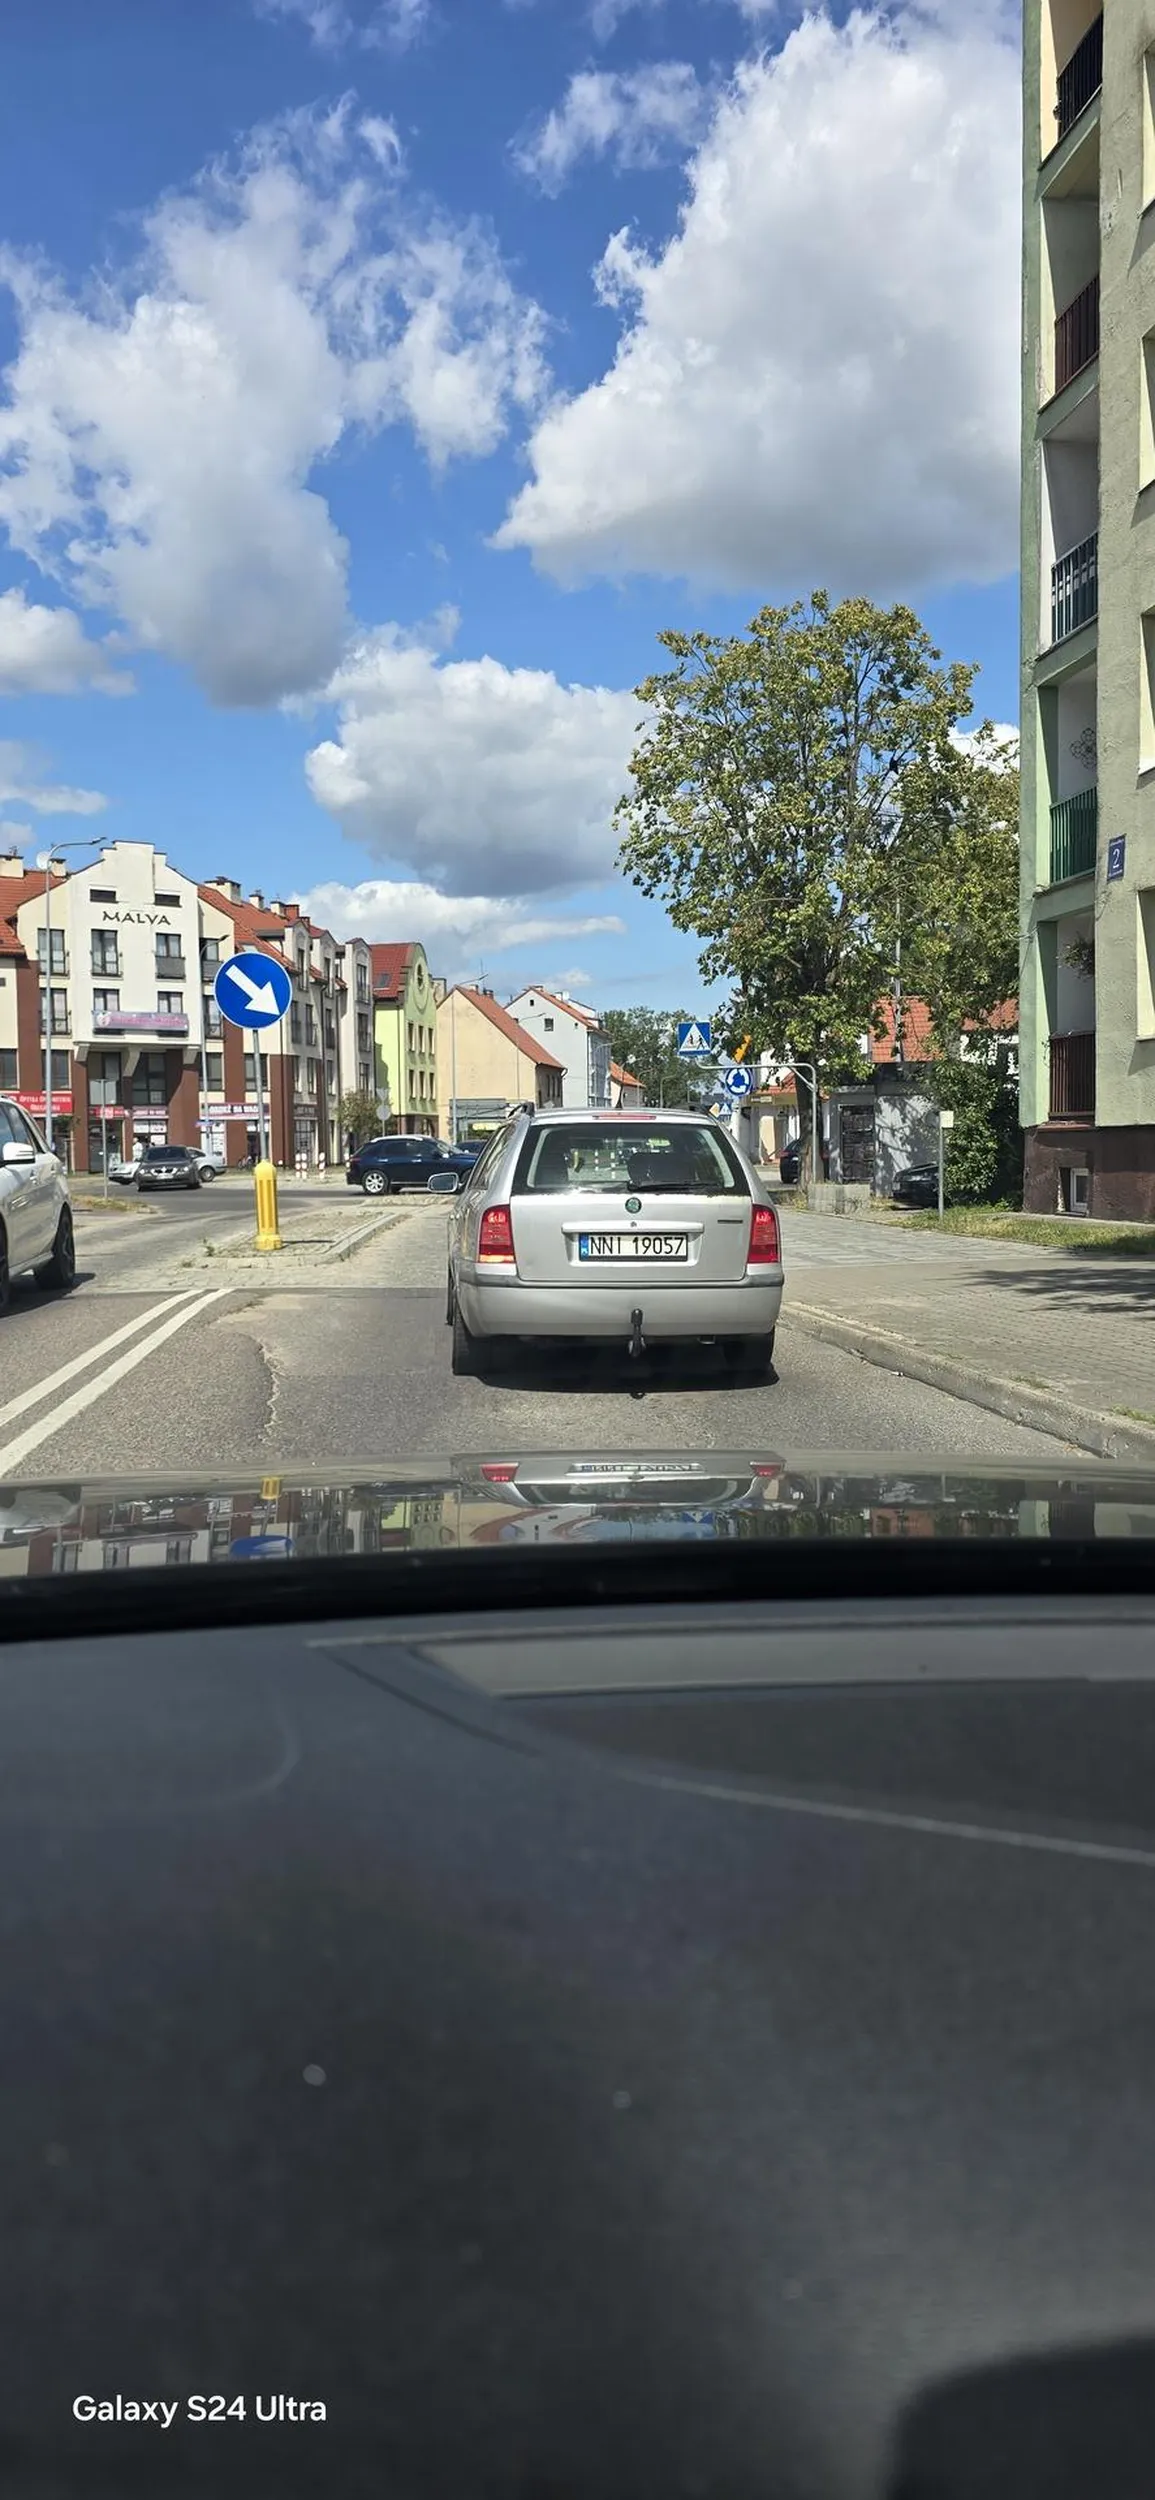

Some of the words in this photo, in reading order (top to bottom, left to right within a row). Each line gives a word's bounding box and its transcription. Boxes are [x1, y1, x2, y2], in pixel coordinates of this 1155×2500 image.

[1112, 848, 1120, 869] 2
[102, 910, 172, 926] MALVA
[590, 1236, 621, 1255] NNI
[632, 1236, 685, 1255] 19057
